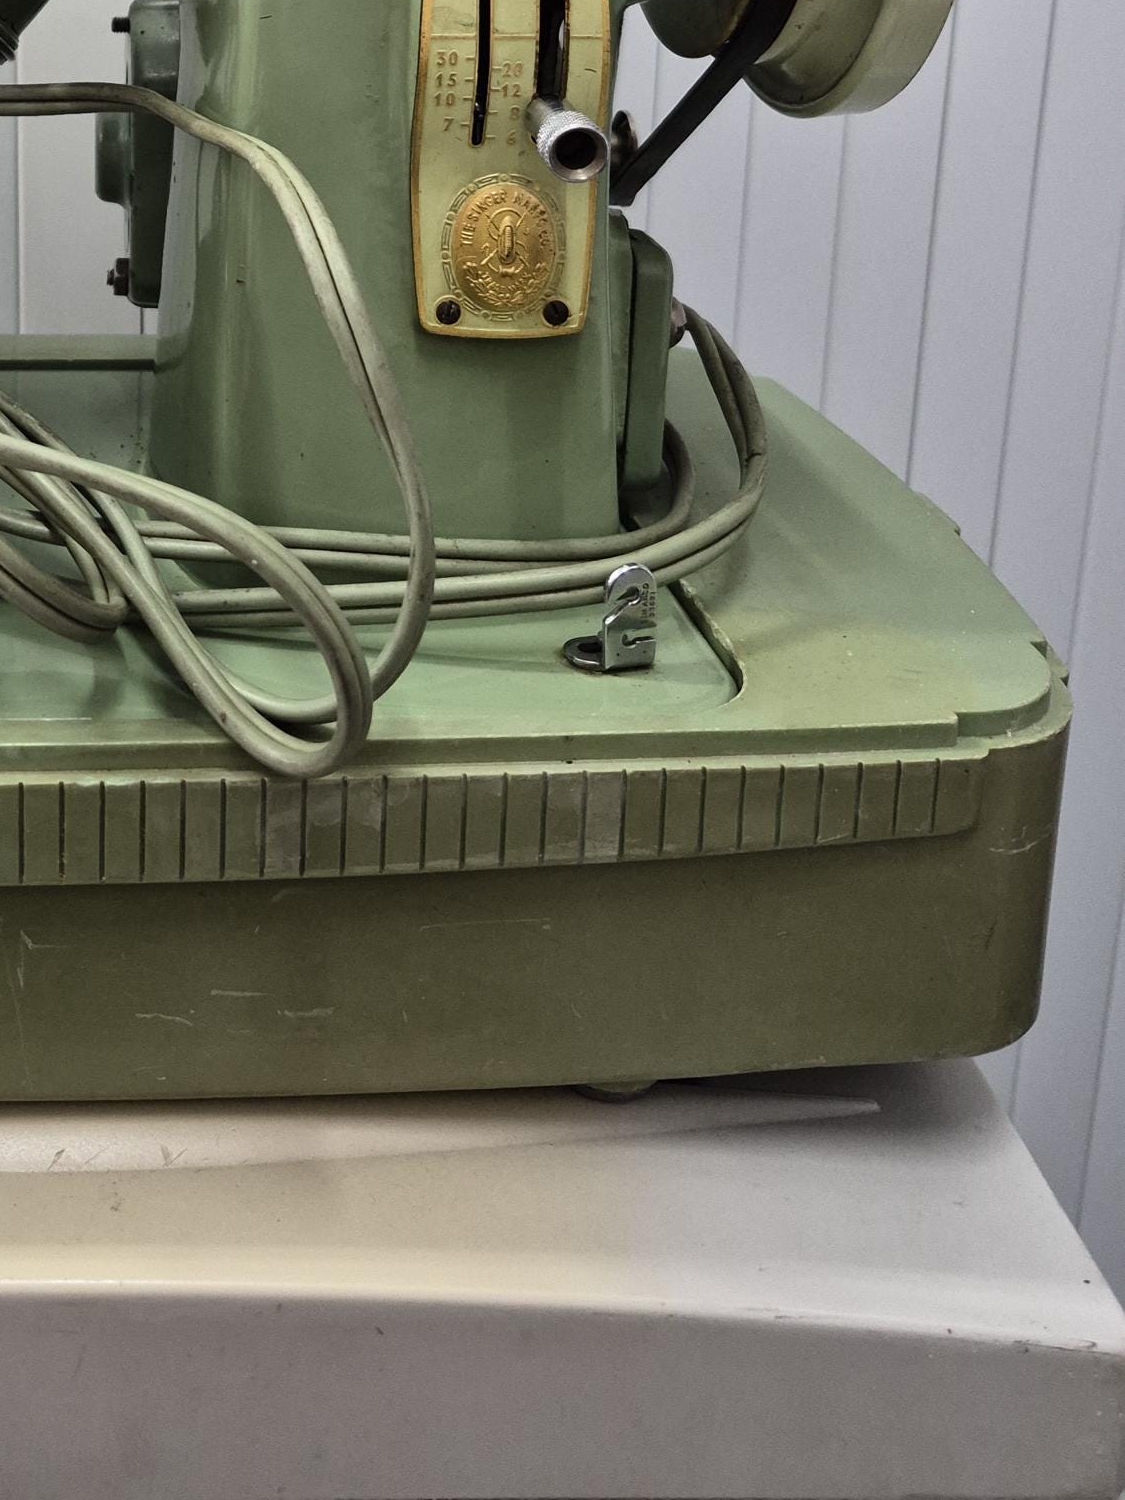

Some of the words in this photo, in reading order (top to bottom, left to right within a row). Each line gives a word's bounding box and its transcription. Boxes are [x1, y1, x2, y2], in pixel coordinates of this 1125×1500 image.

[436, 49, 459, 66] 30
[501, 61, 524, 78] 20
[435, 71, 457, 88] 15
[501, 82, 522, 98] 12
[434, 91, 455, 107] 10
[510, 104, 520, 121] 8
[442, 116, 455, 132] 7
[506, 129, 516, 146] 6
[459, 222, 477, 248] THE
[468, 189, 508, 222] SINGER
